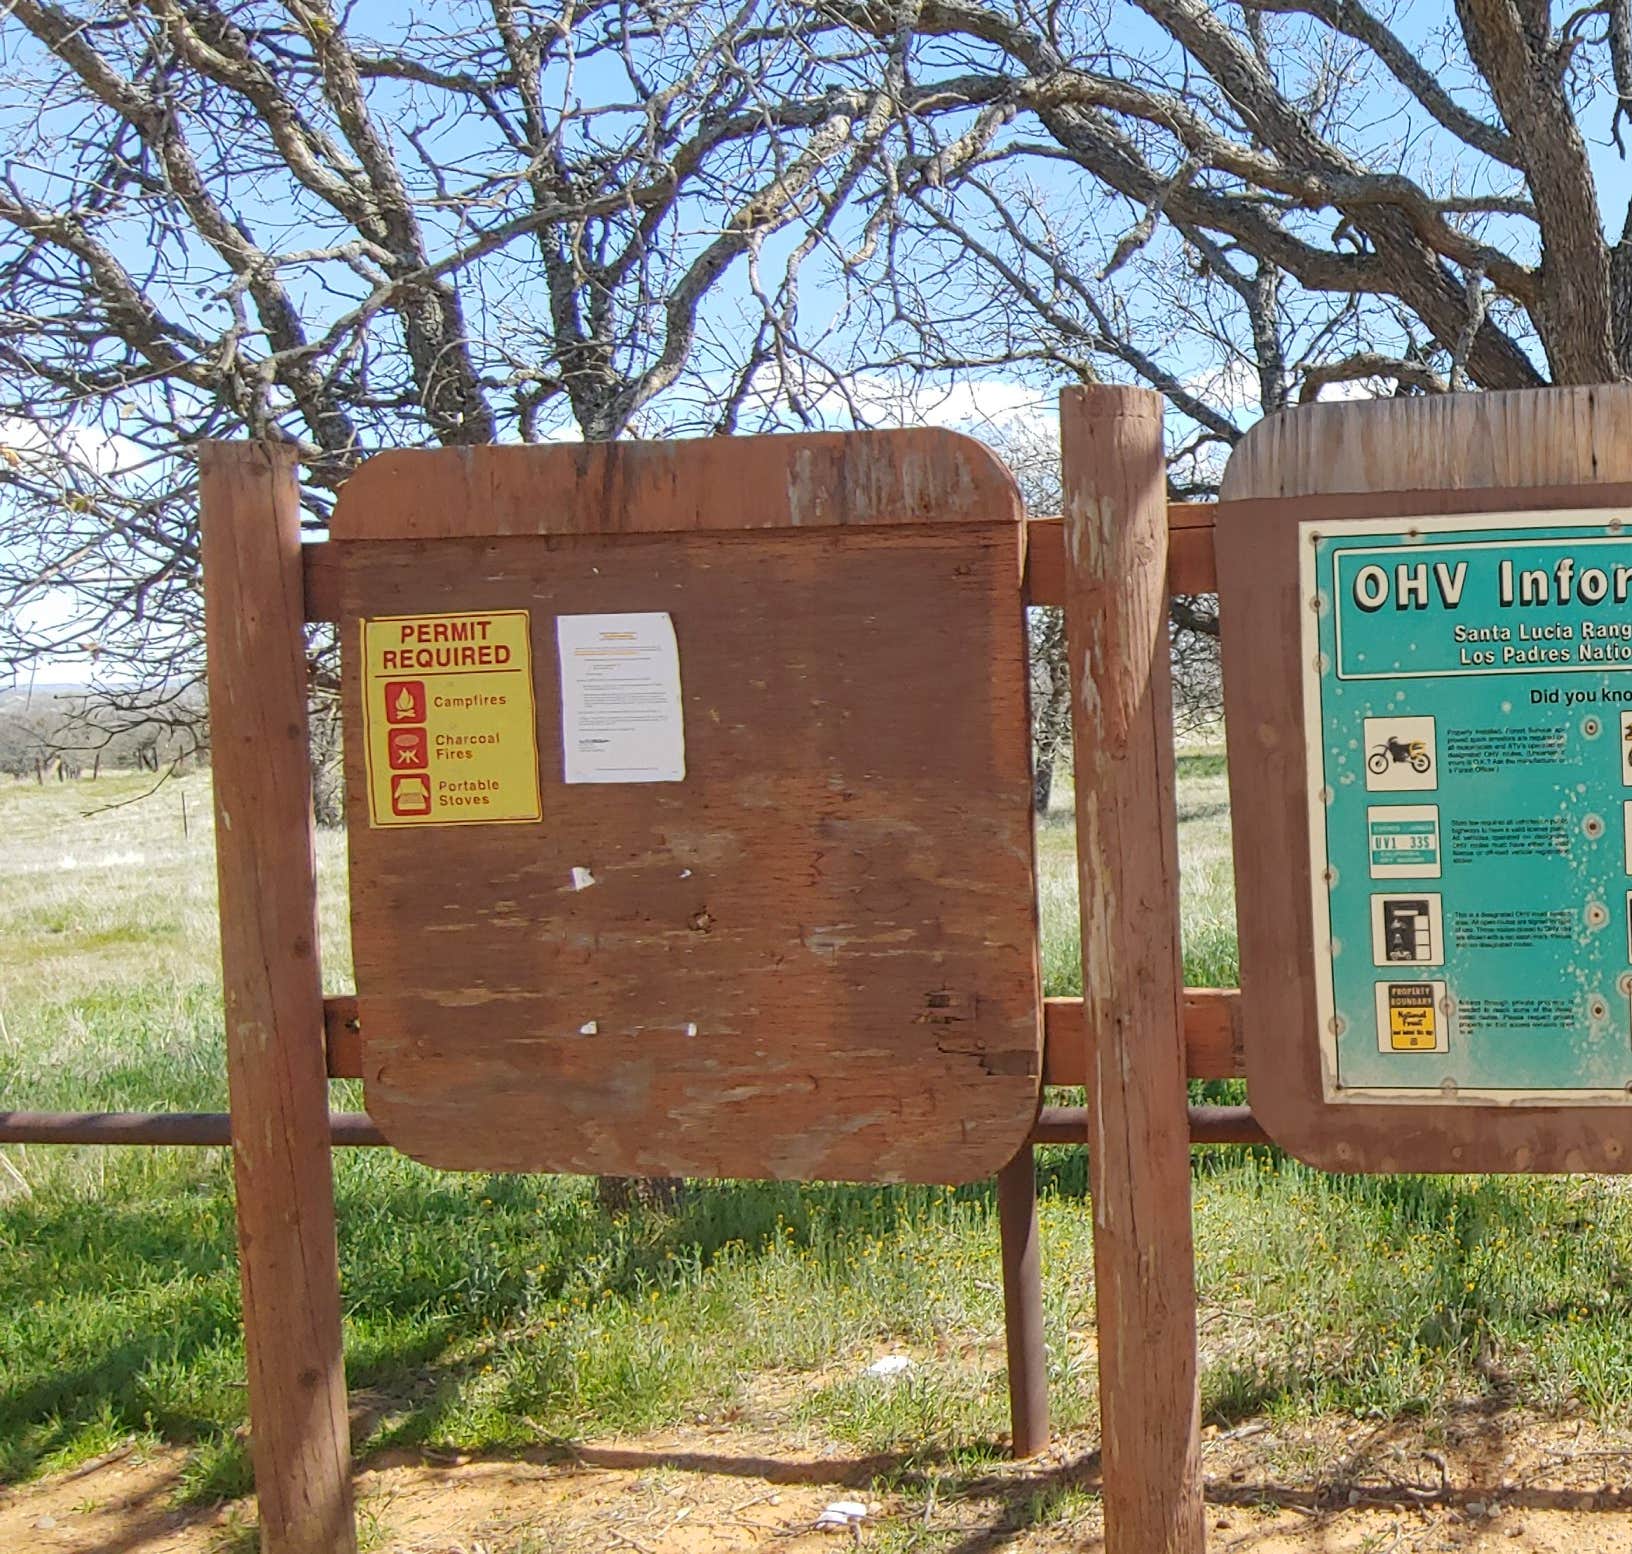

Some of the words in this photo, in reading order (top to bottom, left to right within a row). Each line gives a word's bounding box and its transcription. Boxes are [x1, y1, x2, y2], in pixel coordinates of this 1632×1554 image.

[1353, 560, 1468, 613] OHV
[401, 621, 491, 644] PERMIT
[1454, 623, 1511, 642] Santa
[1519, 621, 1573, 640] Lucia
[383, 645, 511, 670] REQUIRED
[1460, 646, 1494, 664] Los
[1503, 644, 1570, 663] Padres
[434, 695, 506, 708] Campfires
[1530, 688, 1561, 704] Did
[1566, 691, 1596, 707] you
[436, 733, 500, 746] Charcoal
[437, 749, 472, 760] Fires
[439, 780, 499, 792] Portable
[439, 794, 489, 806] Stoves
